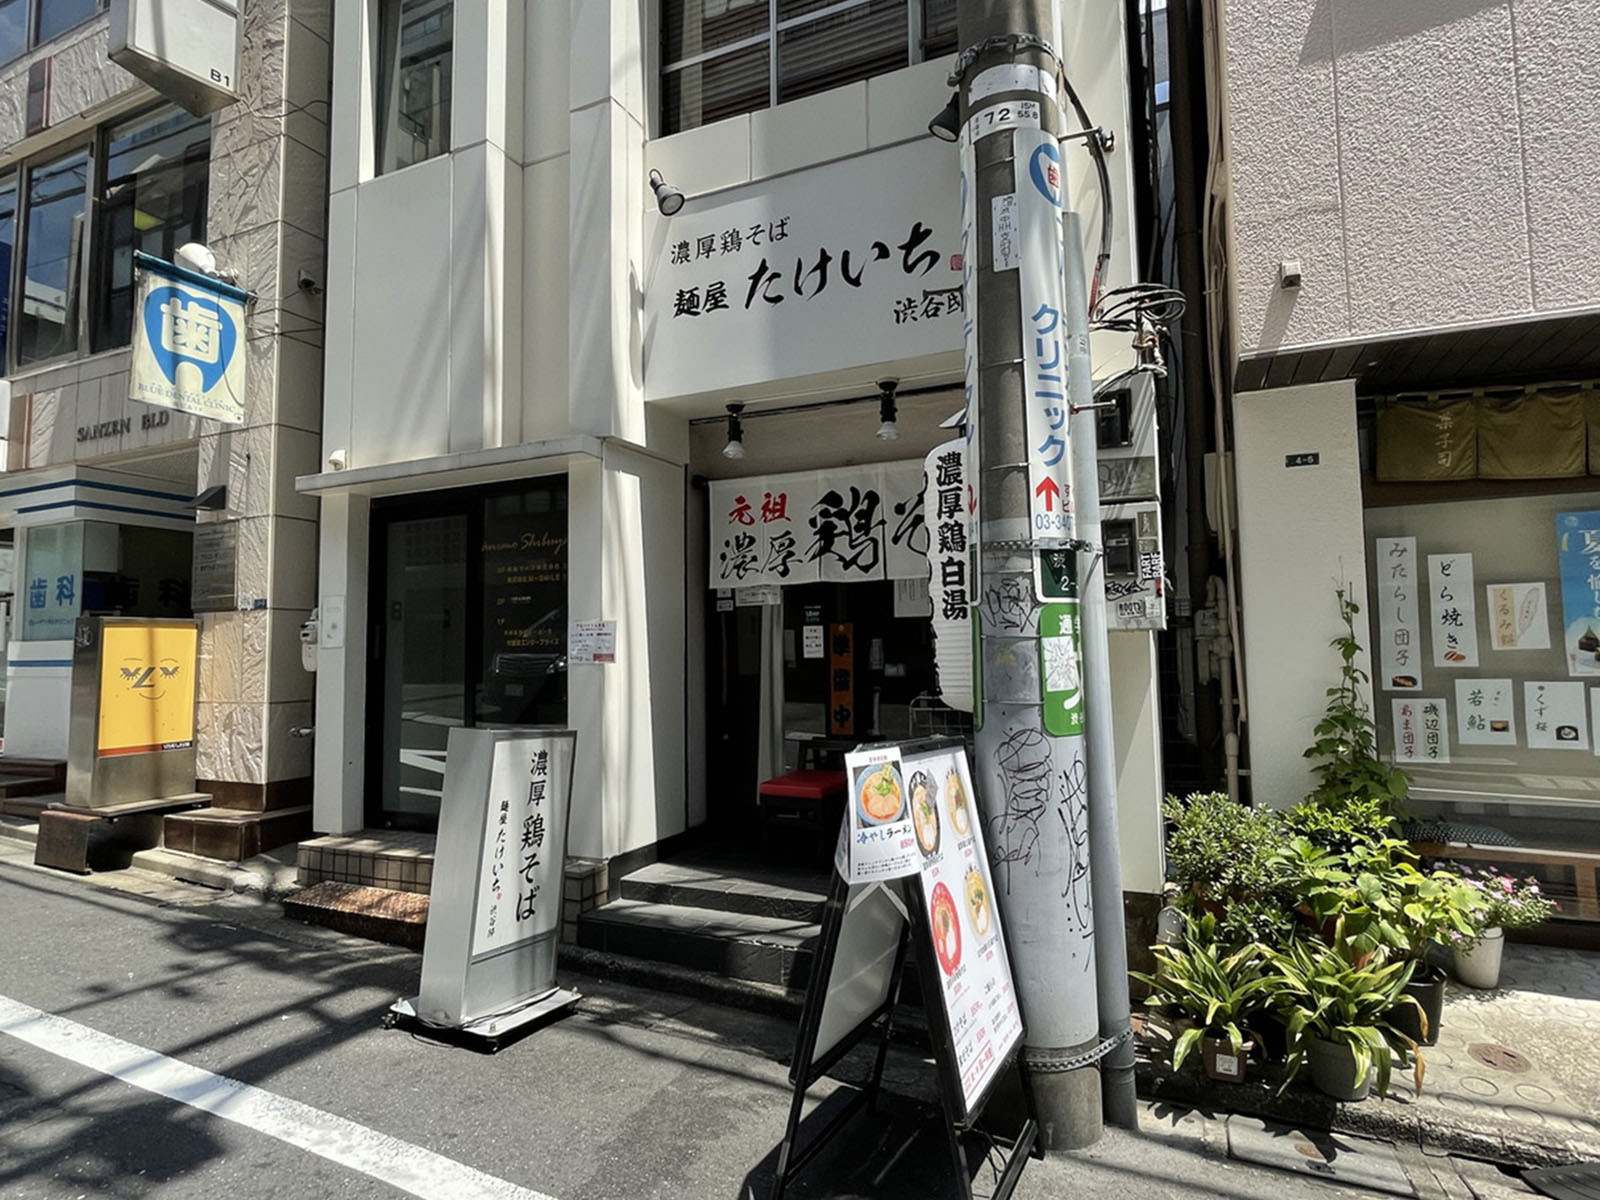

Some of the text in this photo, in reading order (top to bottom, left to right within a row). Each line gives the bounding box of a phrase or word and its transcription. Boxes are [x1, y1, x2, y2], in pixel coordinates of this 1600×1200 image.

[210, 68, 230, 87] B1
[984, 107, 1011, 125] 72
[671, 216, 791, 265] 濃厚鶏そば
[673, 280, 729, 318] 麺屋
[745, 221, 941, 310] たけいち
[160, 296, 223, 364] 歯
[166, 389, 203, 406] DENTAL
[203, 398, 236, 414] CLINIC
[1031, 303, 1066, 467] クリニック
[76, 416, 132, 443] SANZEN
[728, 491, 792, 526] 元祖
[935, 450, 969, 621] 濃厚鶏白湯
[30, 574, 75, 609] 歯科
[1389, 542, 1410, 667] みたらし団子
[1440, 558, 1464, 650] どら焼き
[1467, 689, 1486, 731] 若鮎
[515, 748, 549, 923] 濃厚鶏そば
[856, 825, 912, 846] 冷やしラーメン
